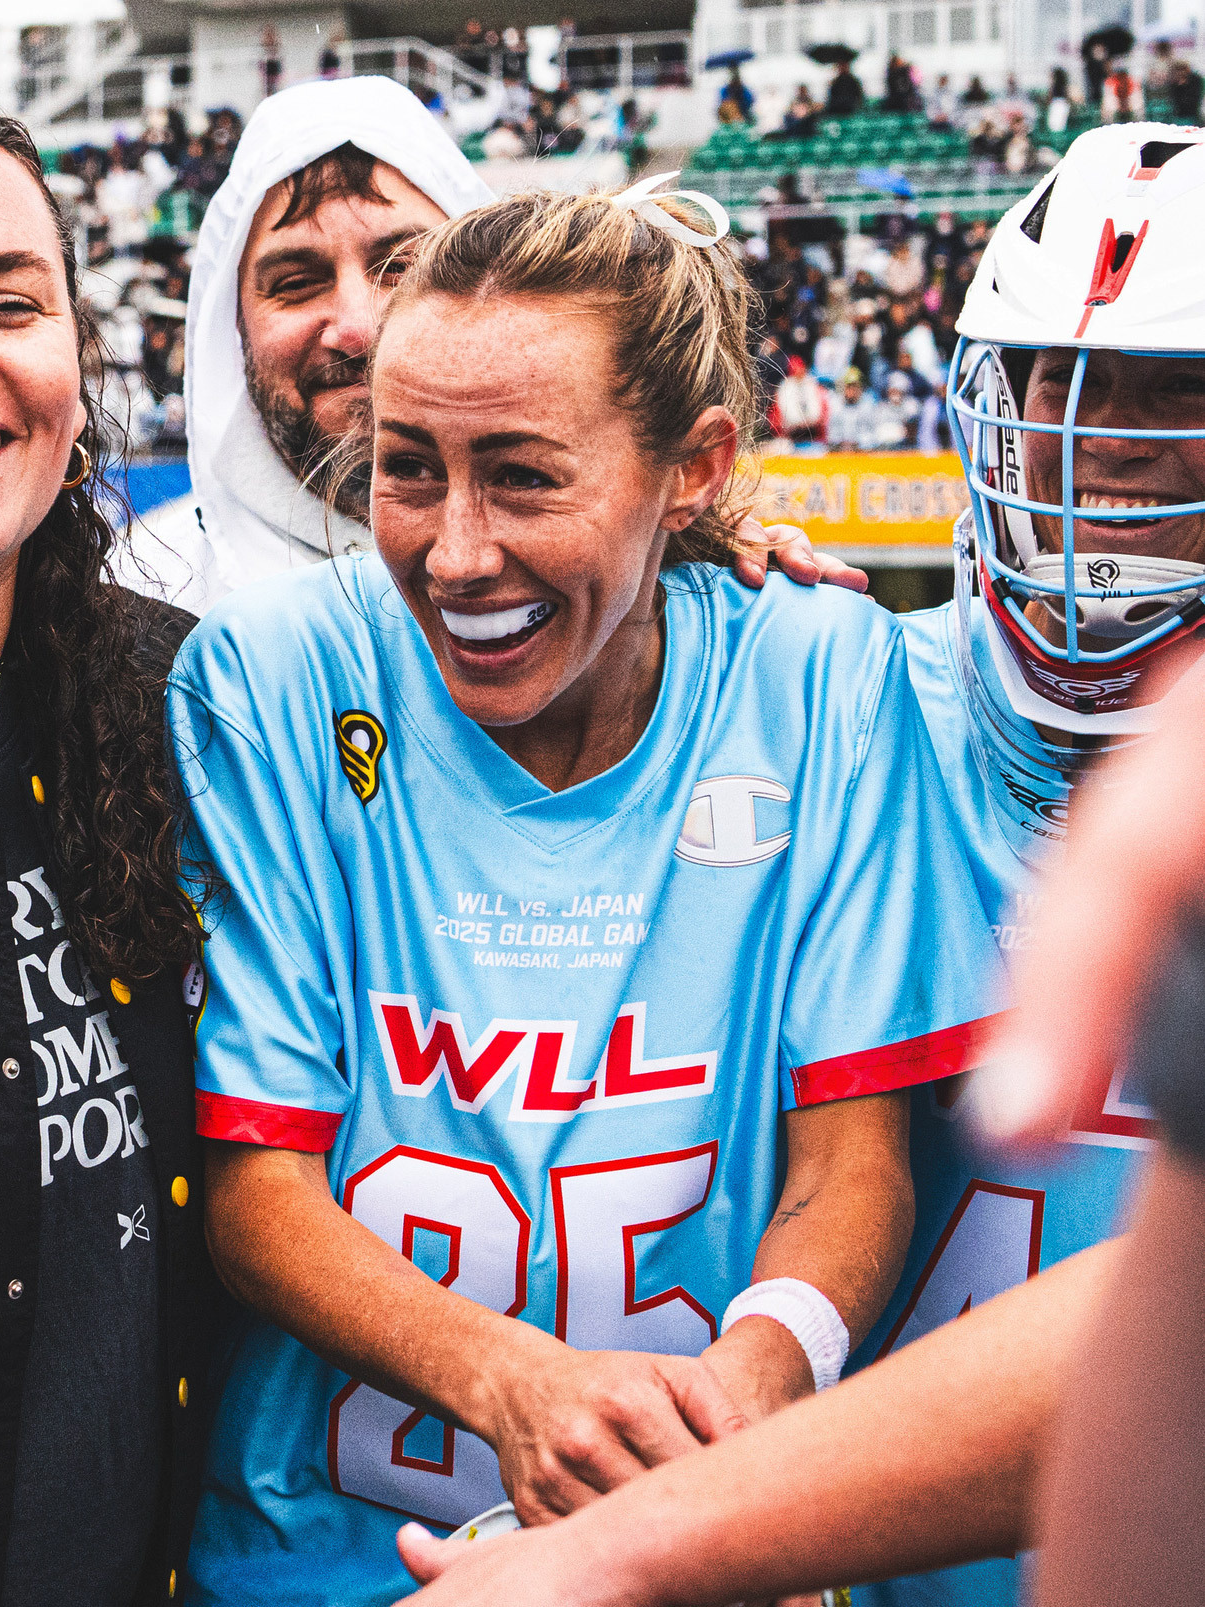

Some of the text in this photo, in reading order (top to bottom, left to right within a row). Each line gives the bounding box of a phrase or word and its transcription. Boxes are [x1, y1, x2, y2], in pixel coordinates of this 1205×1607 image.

[1043, 688, 1128, 706] casde
[456, 891, 508, 917] WLL
[561, 892, 645, 918] JAPAN
[433, 914, 652, 947] 2025 GLOBAL GAM
[566, 951, 624, 969] JAPAN
[368, 988, 718, 1123] WLL
